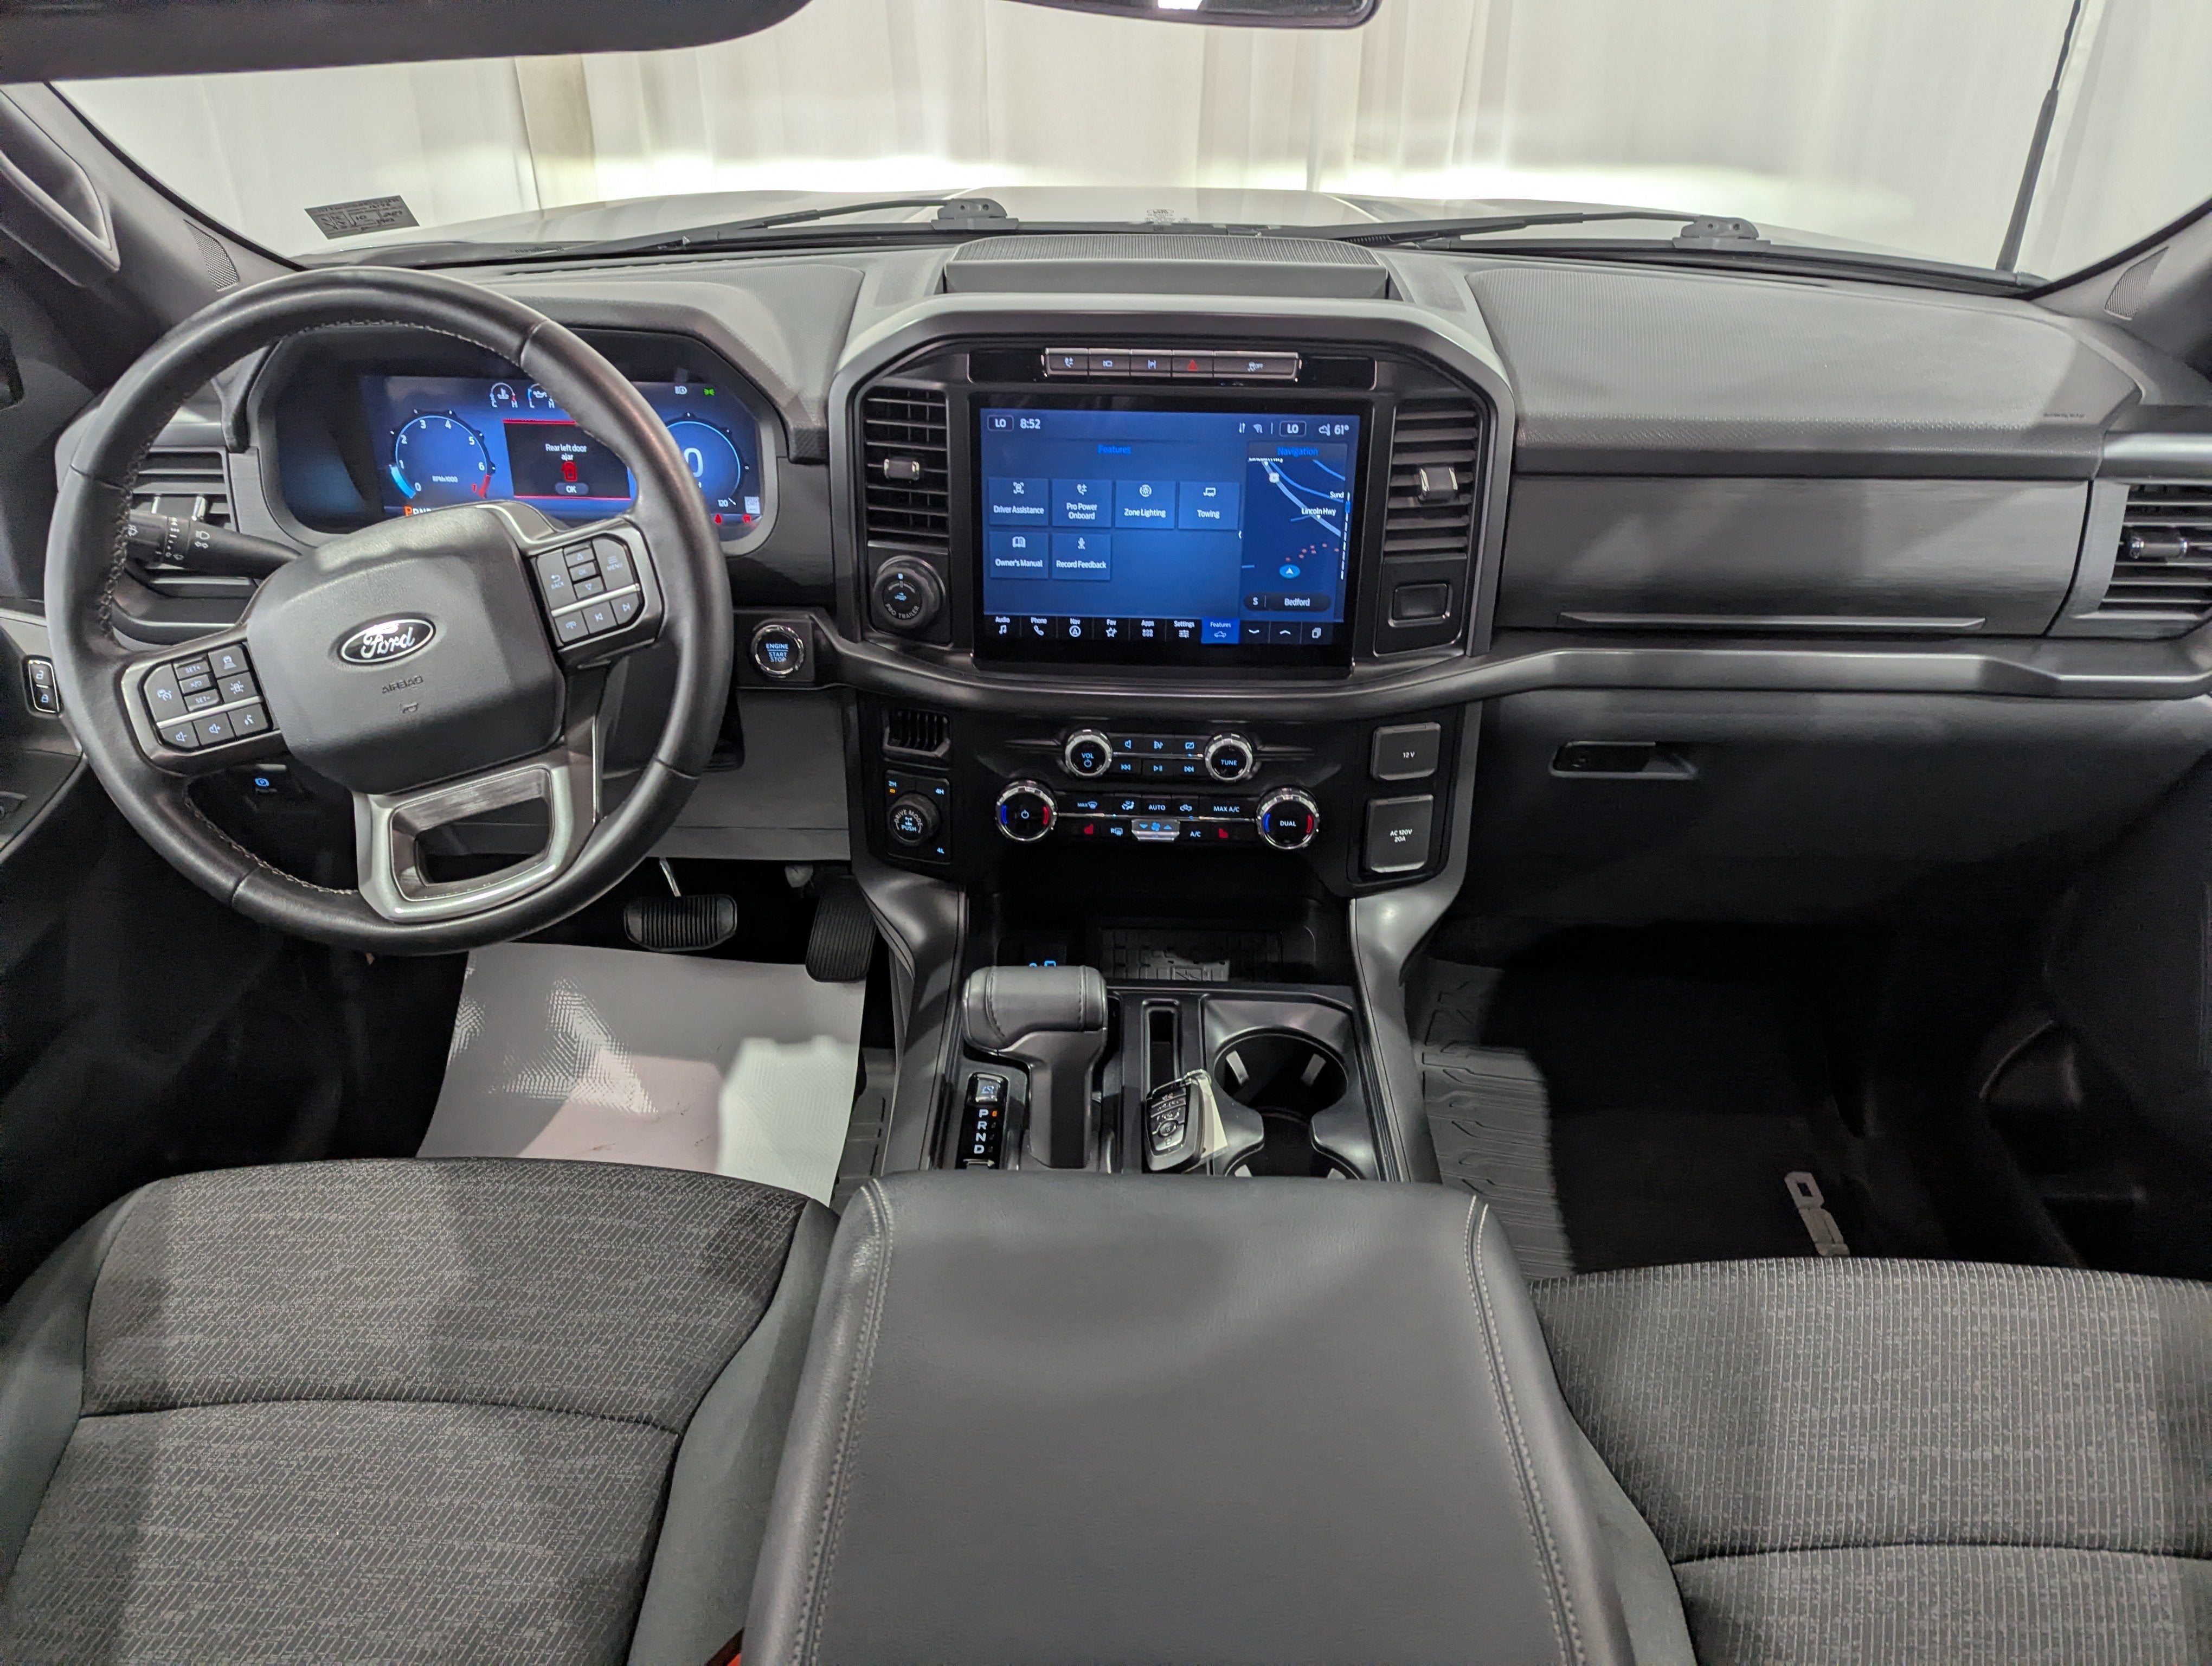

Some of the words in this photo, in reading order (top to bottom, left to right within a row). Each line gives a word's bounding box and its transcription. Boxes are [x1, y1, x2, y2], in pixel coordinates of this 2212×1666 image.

[420, 419, 427, 429] 3
[445, 420, 452, 429] 4
[994, 418, 1007, 427] LO
[1020, 418, 1041, 429] 8:52
[1287, 424, 1299, 434] LO
[401, 434, 407, 444] 2
[468, 436, 475, 445] 5
[545, 443, 560, 452] Rear
[561, 444, 571, 452] left
[572, 444, 587, 452] door
[1097, 444, 1132, 455] Features
[1277, 446, 1319, 458] Navigation
[399, 459, 404, 469] 1
[478, 462, 485, 471] 6
[414, 482, 422, 492] 0
[566, 485, 577, 494] OK
[718, 499, 729, 507] 120
[1066, 502, 1078, 510] Pro
[1078, 503, 1098, 511] Power
[993, 505, 1012, 514] Driver
[1012, 505, 1045, 515] Assistance
[1124, 508, 1140, 516] Zone
[1140, 508, 1166, 518] Lighting
[1197, 509, 1220, 519] Towing
[1301, 507, 1322, 515] Lincoln
[1323, 508, 1336, 516] Hwy
[1068, 511, 1096, 520] Onboard
[995, 558, 1020, 567] Owner's
[1020, 559, 1043, 568] Manual
[1056, 560, 1077, 568] Record
[1078, 560, 1107, 569] Feedback
[1252, 597, 1258, 606] S
[1284, 598, 1310, 606] Bedford
[898, 605, 919, 619] TRAILER
[360, 624, 416, 658] Ford
[894, 809, 907, 824] DRIVE
[909, 810, 923, 826] MODE
[901, 824, 916, 832] PUSH
[979, 1109, 989, 1118] P
[978, 1121, 987, 1130] R
[975, 1133, 986, 1142] N
[974, 1144, 985, 1154] D
